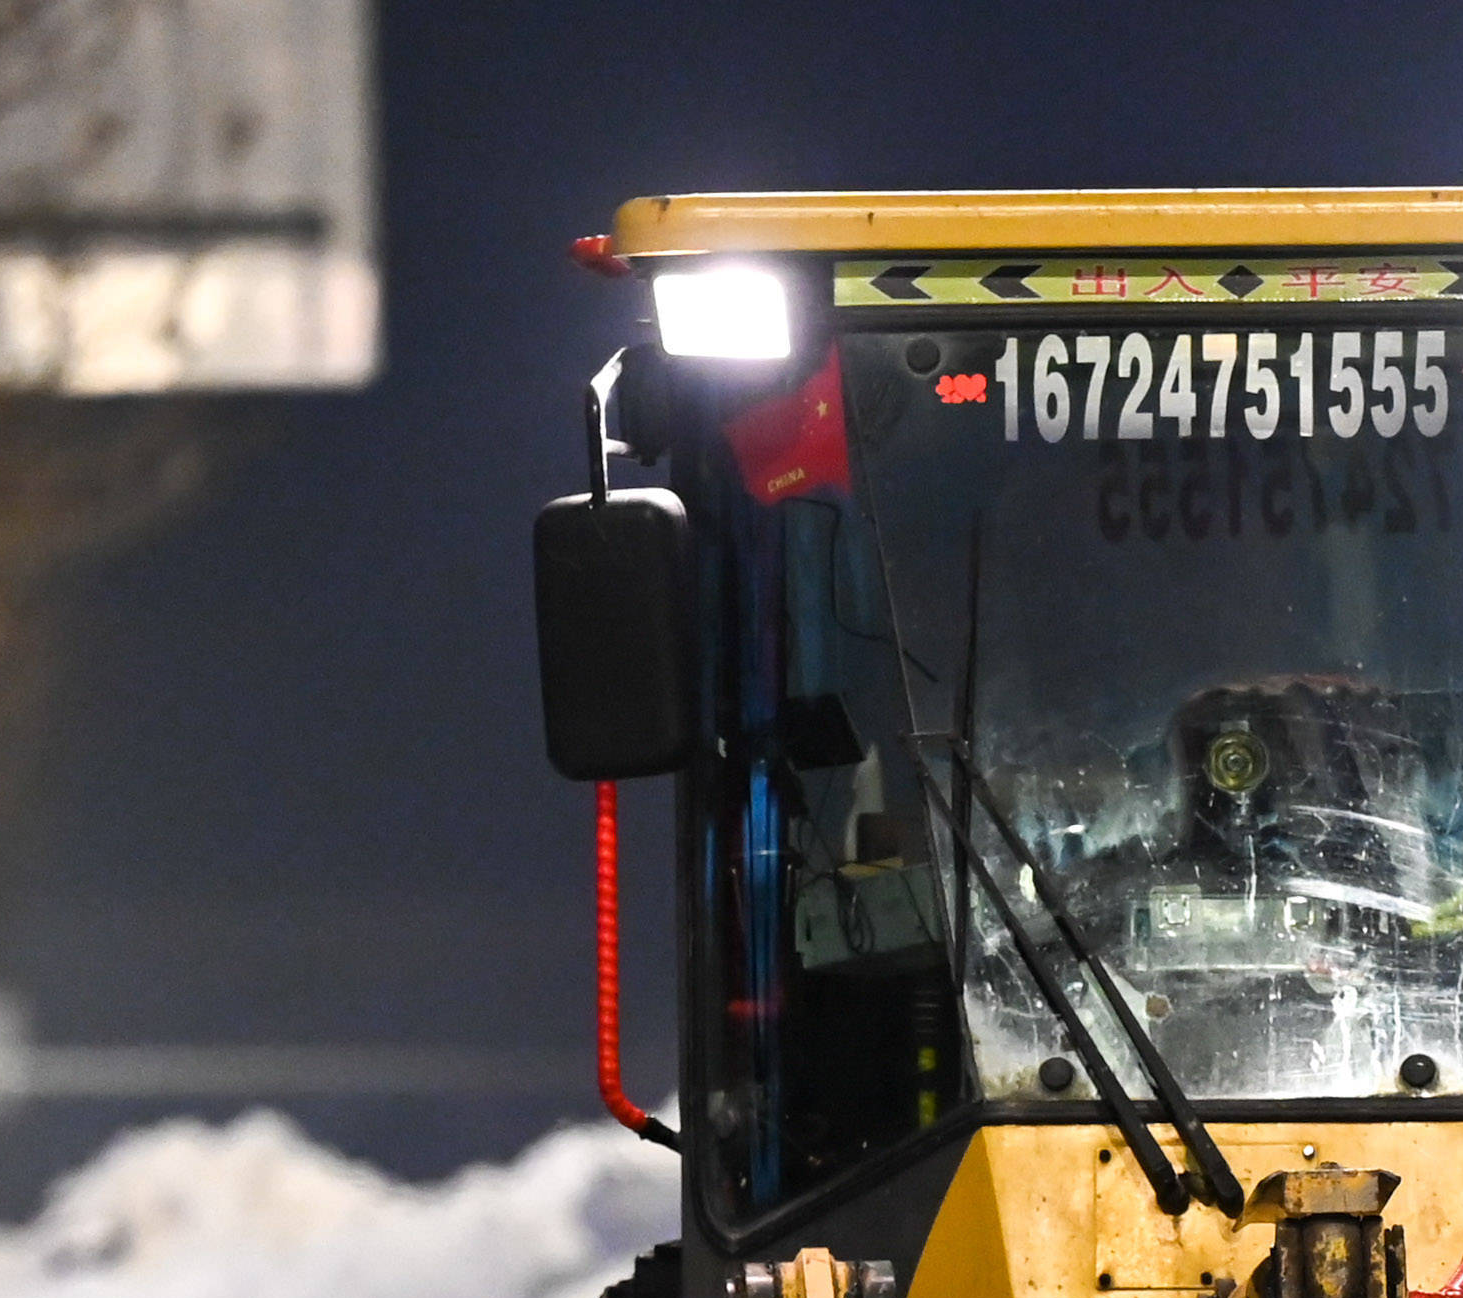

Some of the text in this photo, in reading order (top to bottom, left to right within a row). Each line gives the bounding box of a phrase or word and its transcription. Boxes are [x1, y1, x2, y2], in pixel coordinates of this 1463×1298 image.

[1071, 263, 1420, 298] 出入 平安
[995, 330, 1448, 442] 16724751555
[767, 467, 805, 494] CHINA
